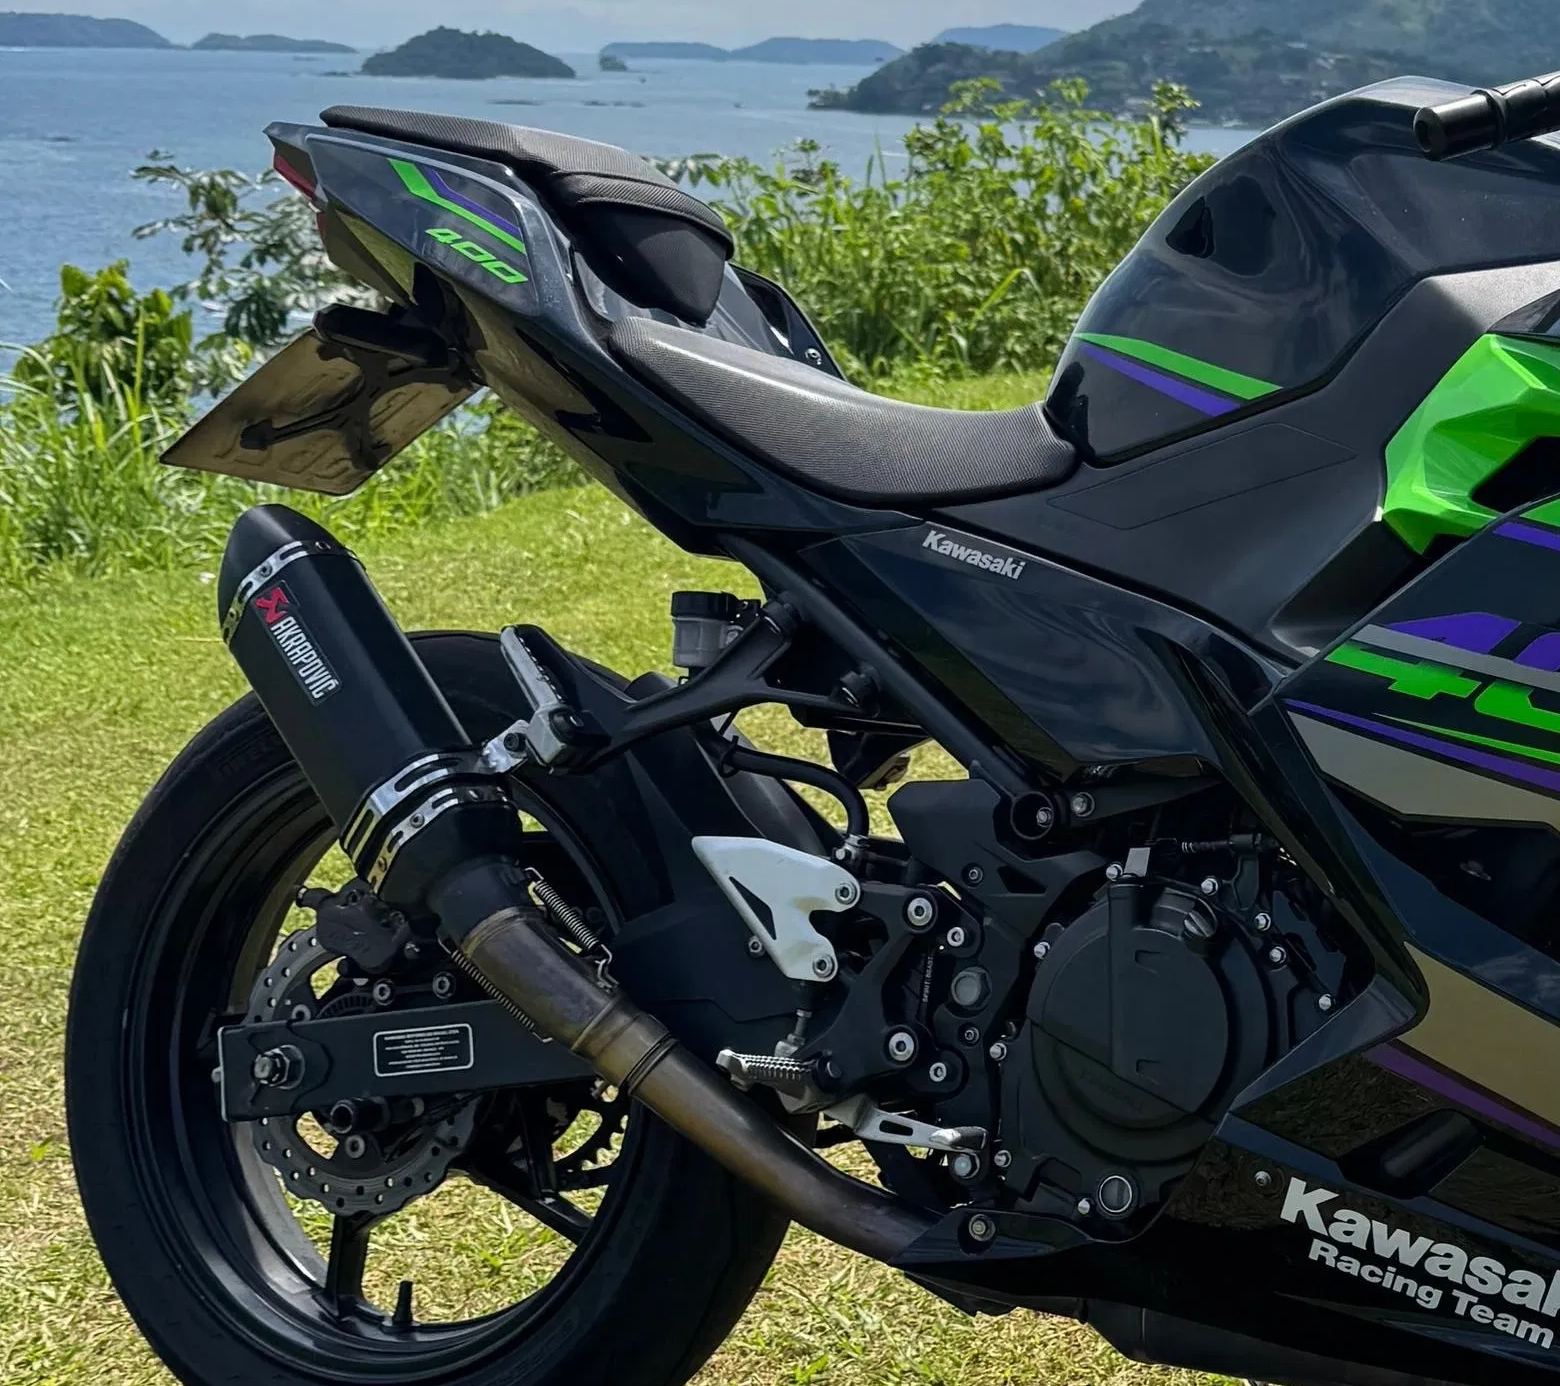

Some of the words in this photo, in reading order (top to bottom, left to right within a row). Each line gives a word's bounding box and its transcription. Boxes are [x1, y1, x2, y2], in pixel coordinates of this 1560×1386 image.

[425, 228, 528, 284] 400
[922, 530, 1026, 580] Kawasaki
[1308, 1239, 1442, 1309] Racing
[1451, 1289, 1555, 1349] Team
